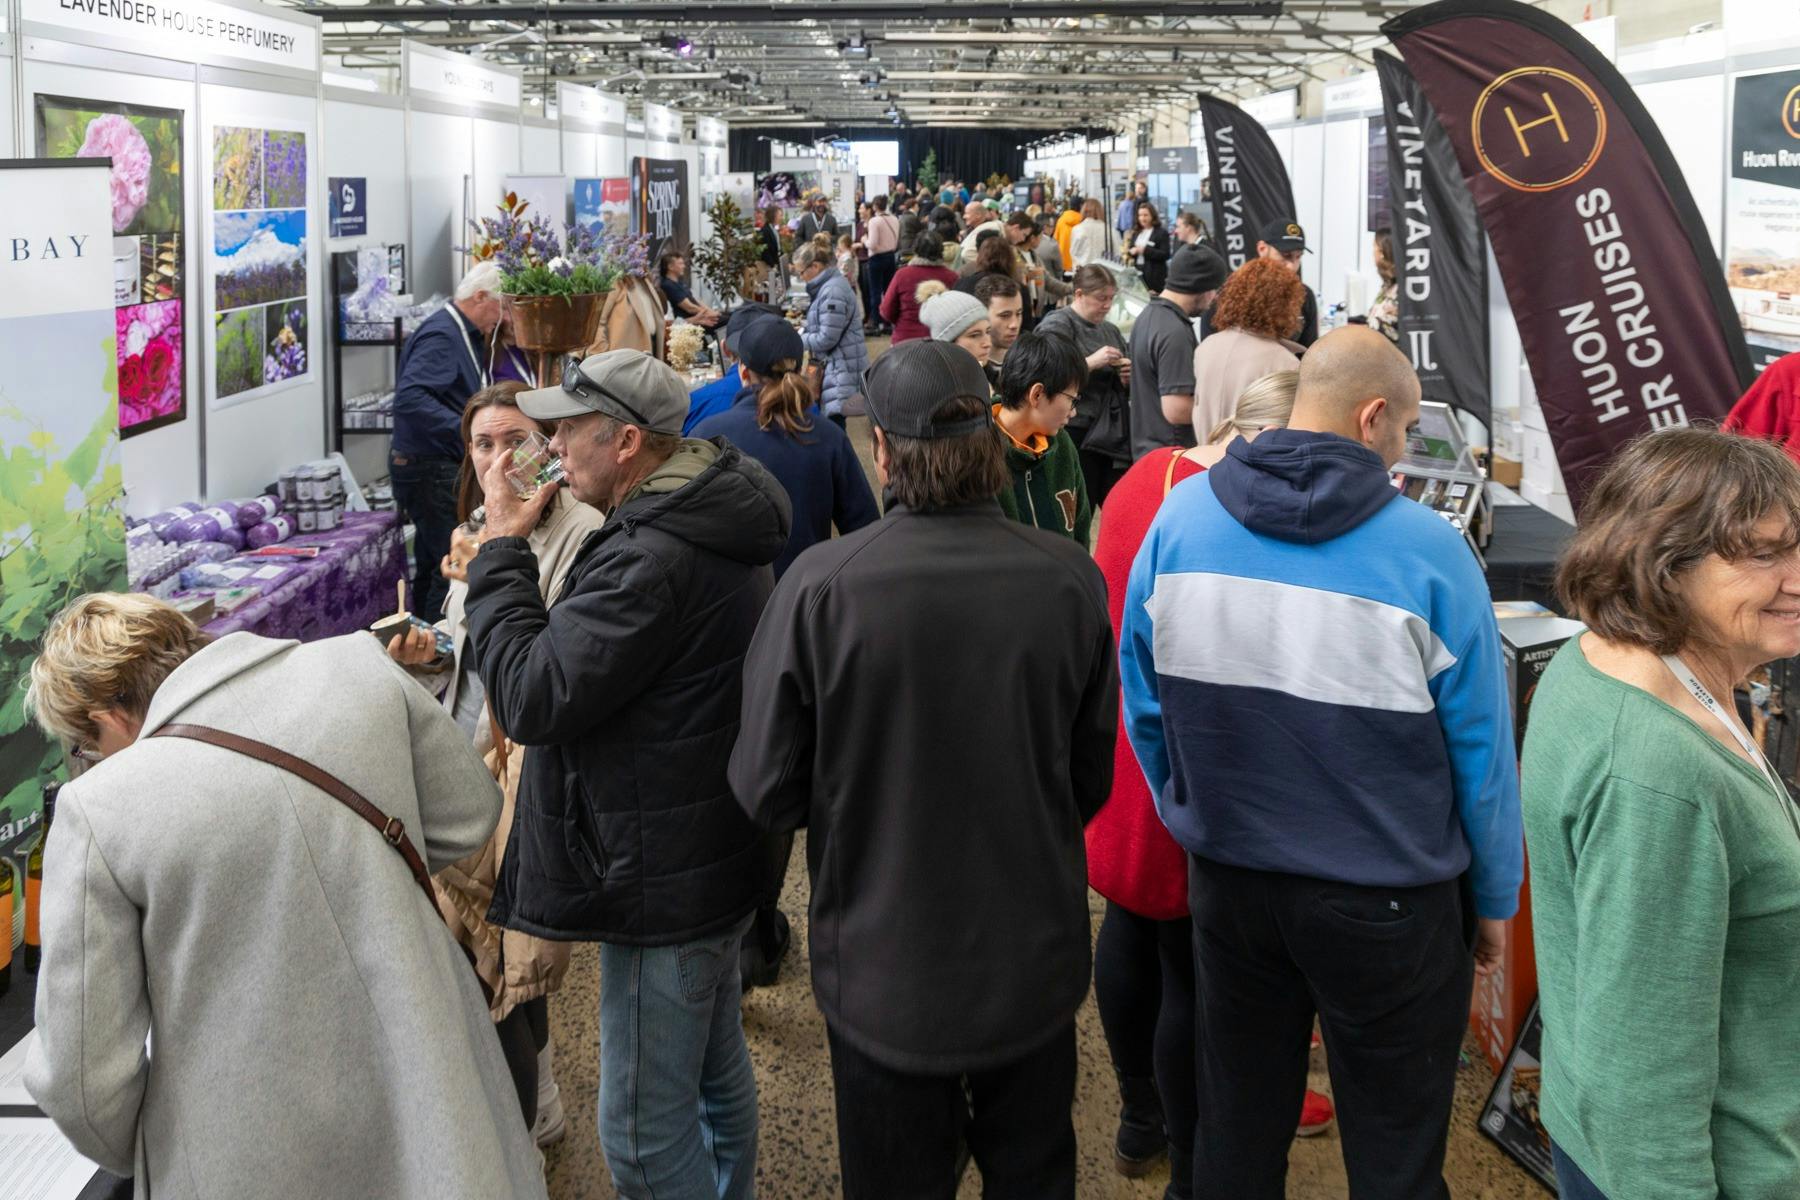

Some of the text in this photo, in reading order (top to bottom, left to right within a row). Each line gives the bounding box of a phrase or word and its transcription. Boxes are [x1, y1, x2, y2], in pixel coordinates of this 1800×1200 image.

[163, 8, 215, 37] HOUSE
[219, 21, 296, 54] PERFUMERY
[1504, 92, 1570, 157] H
[647, 179, 680, 214] SPRING
[656, 208, 673, 240] BAY
[1214, 125, 1247, 272] VINEYARD
[1396, 100, 1432, 302] VINEYARD
[10, 234, 89, 261] BAY
[1575, 187, 1665, 368] CRUISES
[1558, 300, 1631, 424] HUON
[1688, 678, 1710, 699] HOBART
